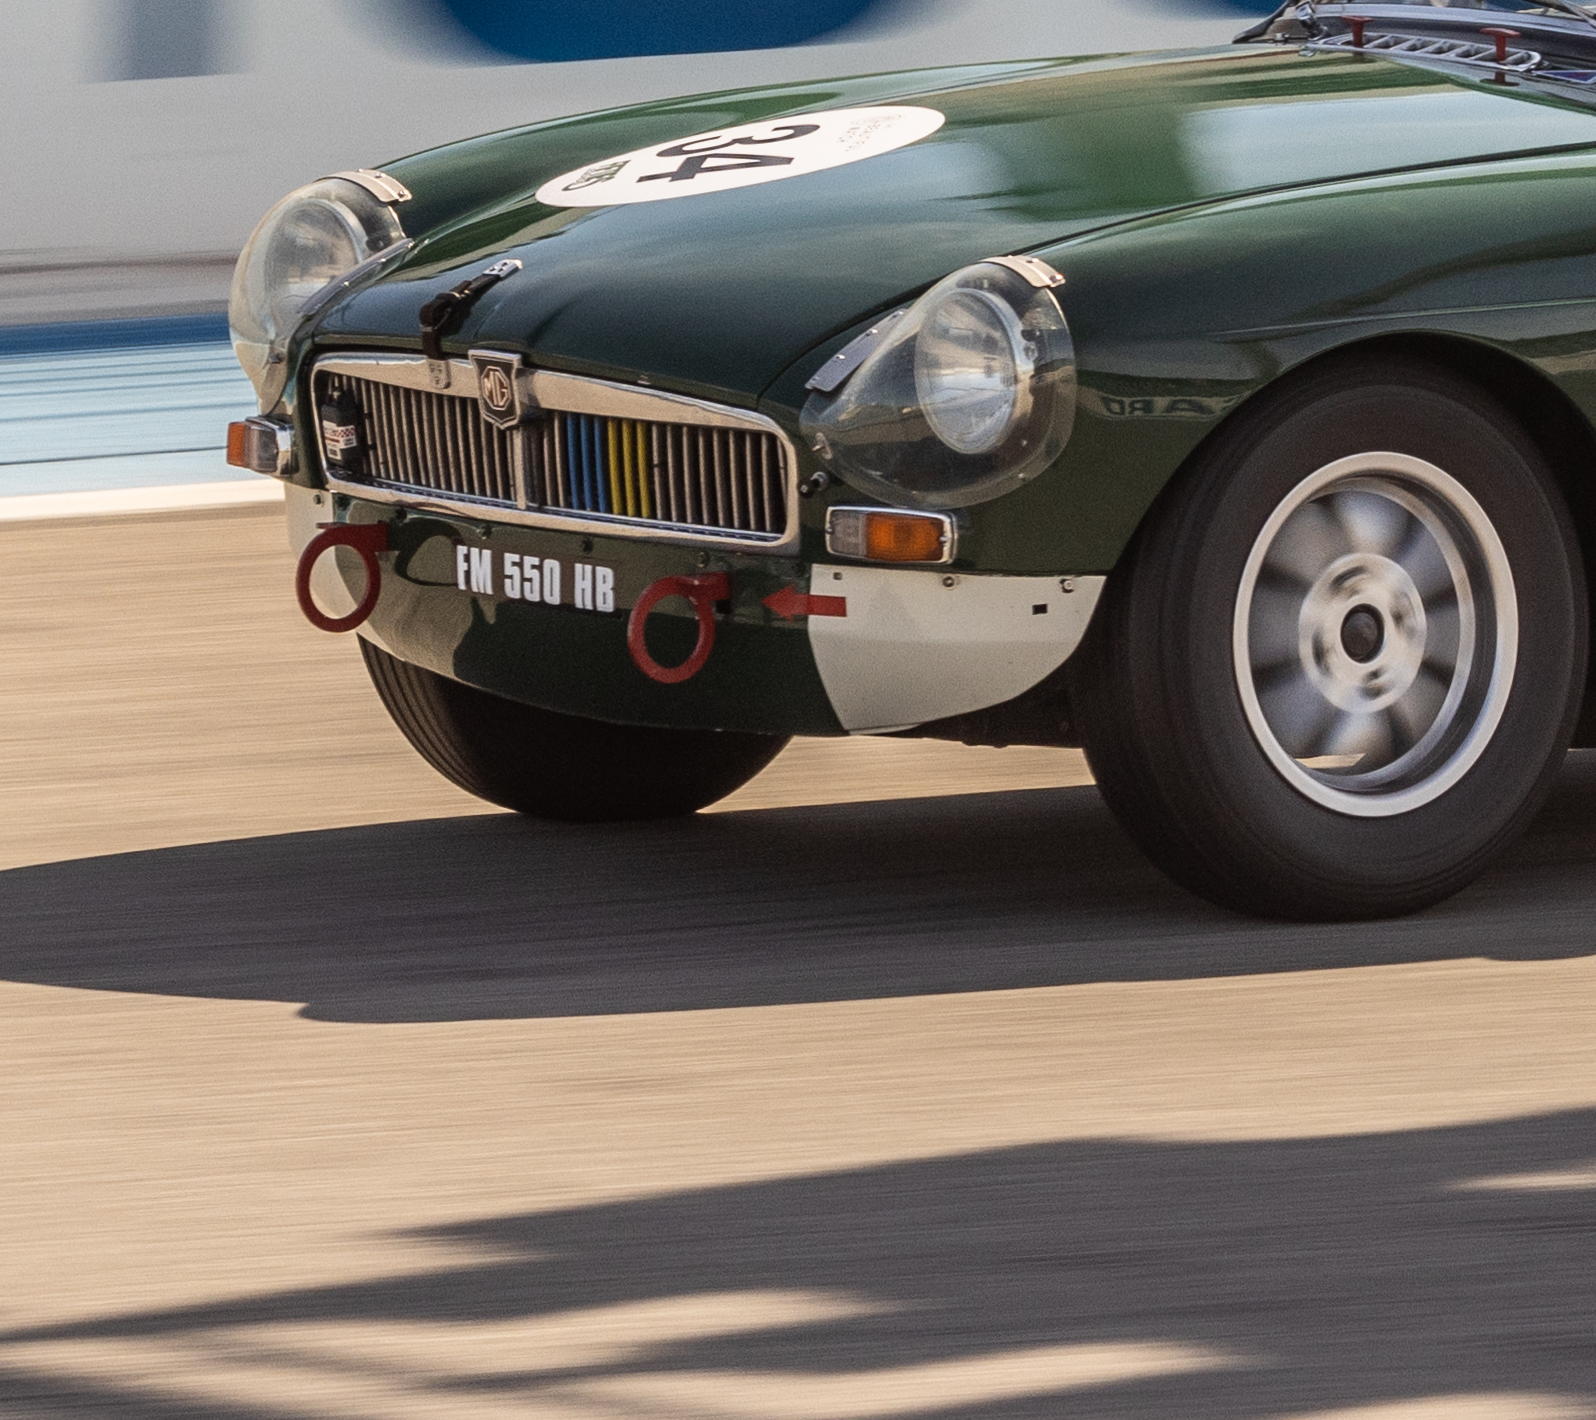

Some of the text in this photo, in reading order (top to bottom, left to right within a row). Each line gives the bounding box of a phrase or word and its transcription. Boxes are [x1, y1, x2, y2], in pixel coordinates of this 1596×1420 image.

[636, 124, 821, 183] 34
[483, 369, 509, 409] MG
[456, 545, 615, 613] FM 550 HB
